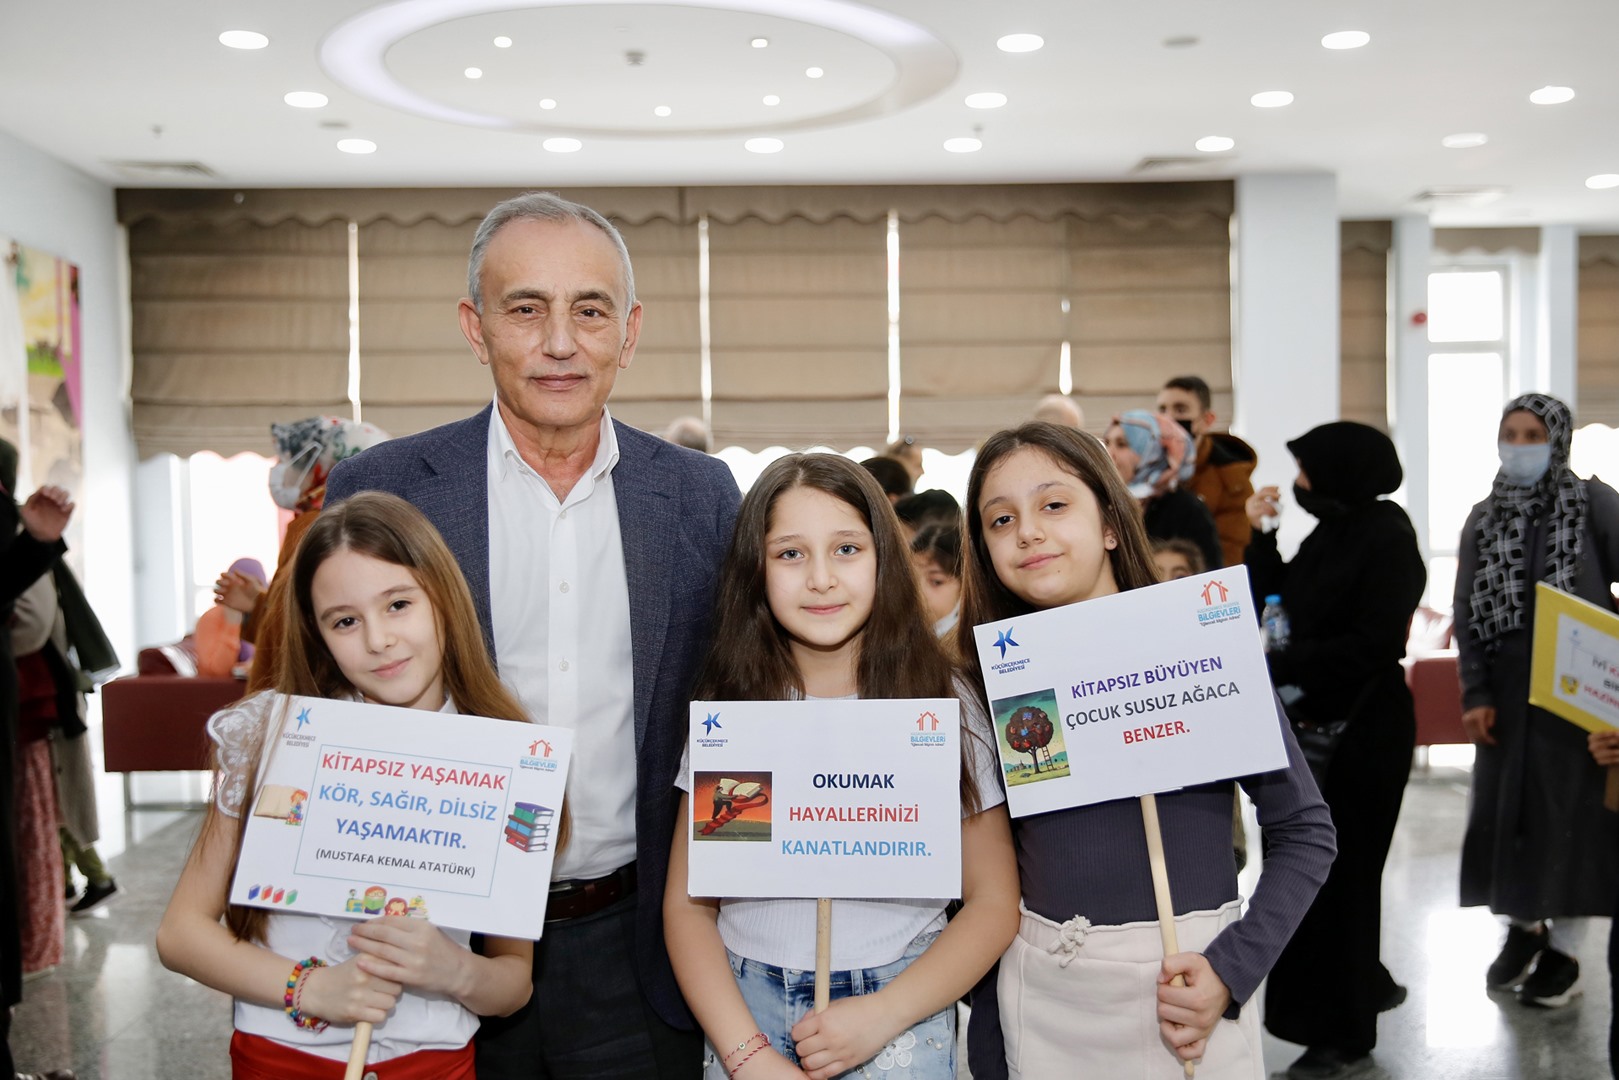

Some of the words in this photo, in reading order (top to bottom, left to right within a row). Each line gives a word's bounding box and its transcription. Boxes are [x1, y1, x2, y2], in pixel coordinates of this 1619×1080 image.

[1071, 672, 1141, 699] KİTAPSIZ
[1144, 656, 1223, 684] BÜYÜYEN
[1065, 705, 1122, 730] ÇOCUK
[1124, 693, 1178, 716] SUSUZ
[1182, 681, 1241, 705] AĞACA
[1123, 720, 1191, 745] BENZER.
[322, 751, 405, 777] KİTAPSIZ
[411, 763, 506, 790] YAŞAMAK
[812, 774, 895, 789] OKUMAK
[318, 783, 364, 807] KÖR,
[370, 790, 433, 815] SAĞIR,
[439, 797, 498, 821] DİLSİZ
[789, 804, 919, 822] HAYALLERİNİZİ
[336, 818, 467, 849] YAŞAMAKTIR.
[782, 840, 932, 857] KANATLANDIRIR.
[316, 848, 375, 865] (MUSTAFA
[377, 856, 416, 869] KEMAL
[418, 860, 476, 879] ATATÜRK)
